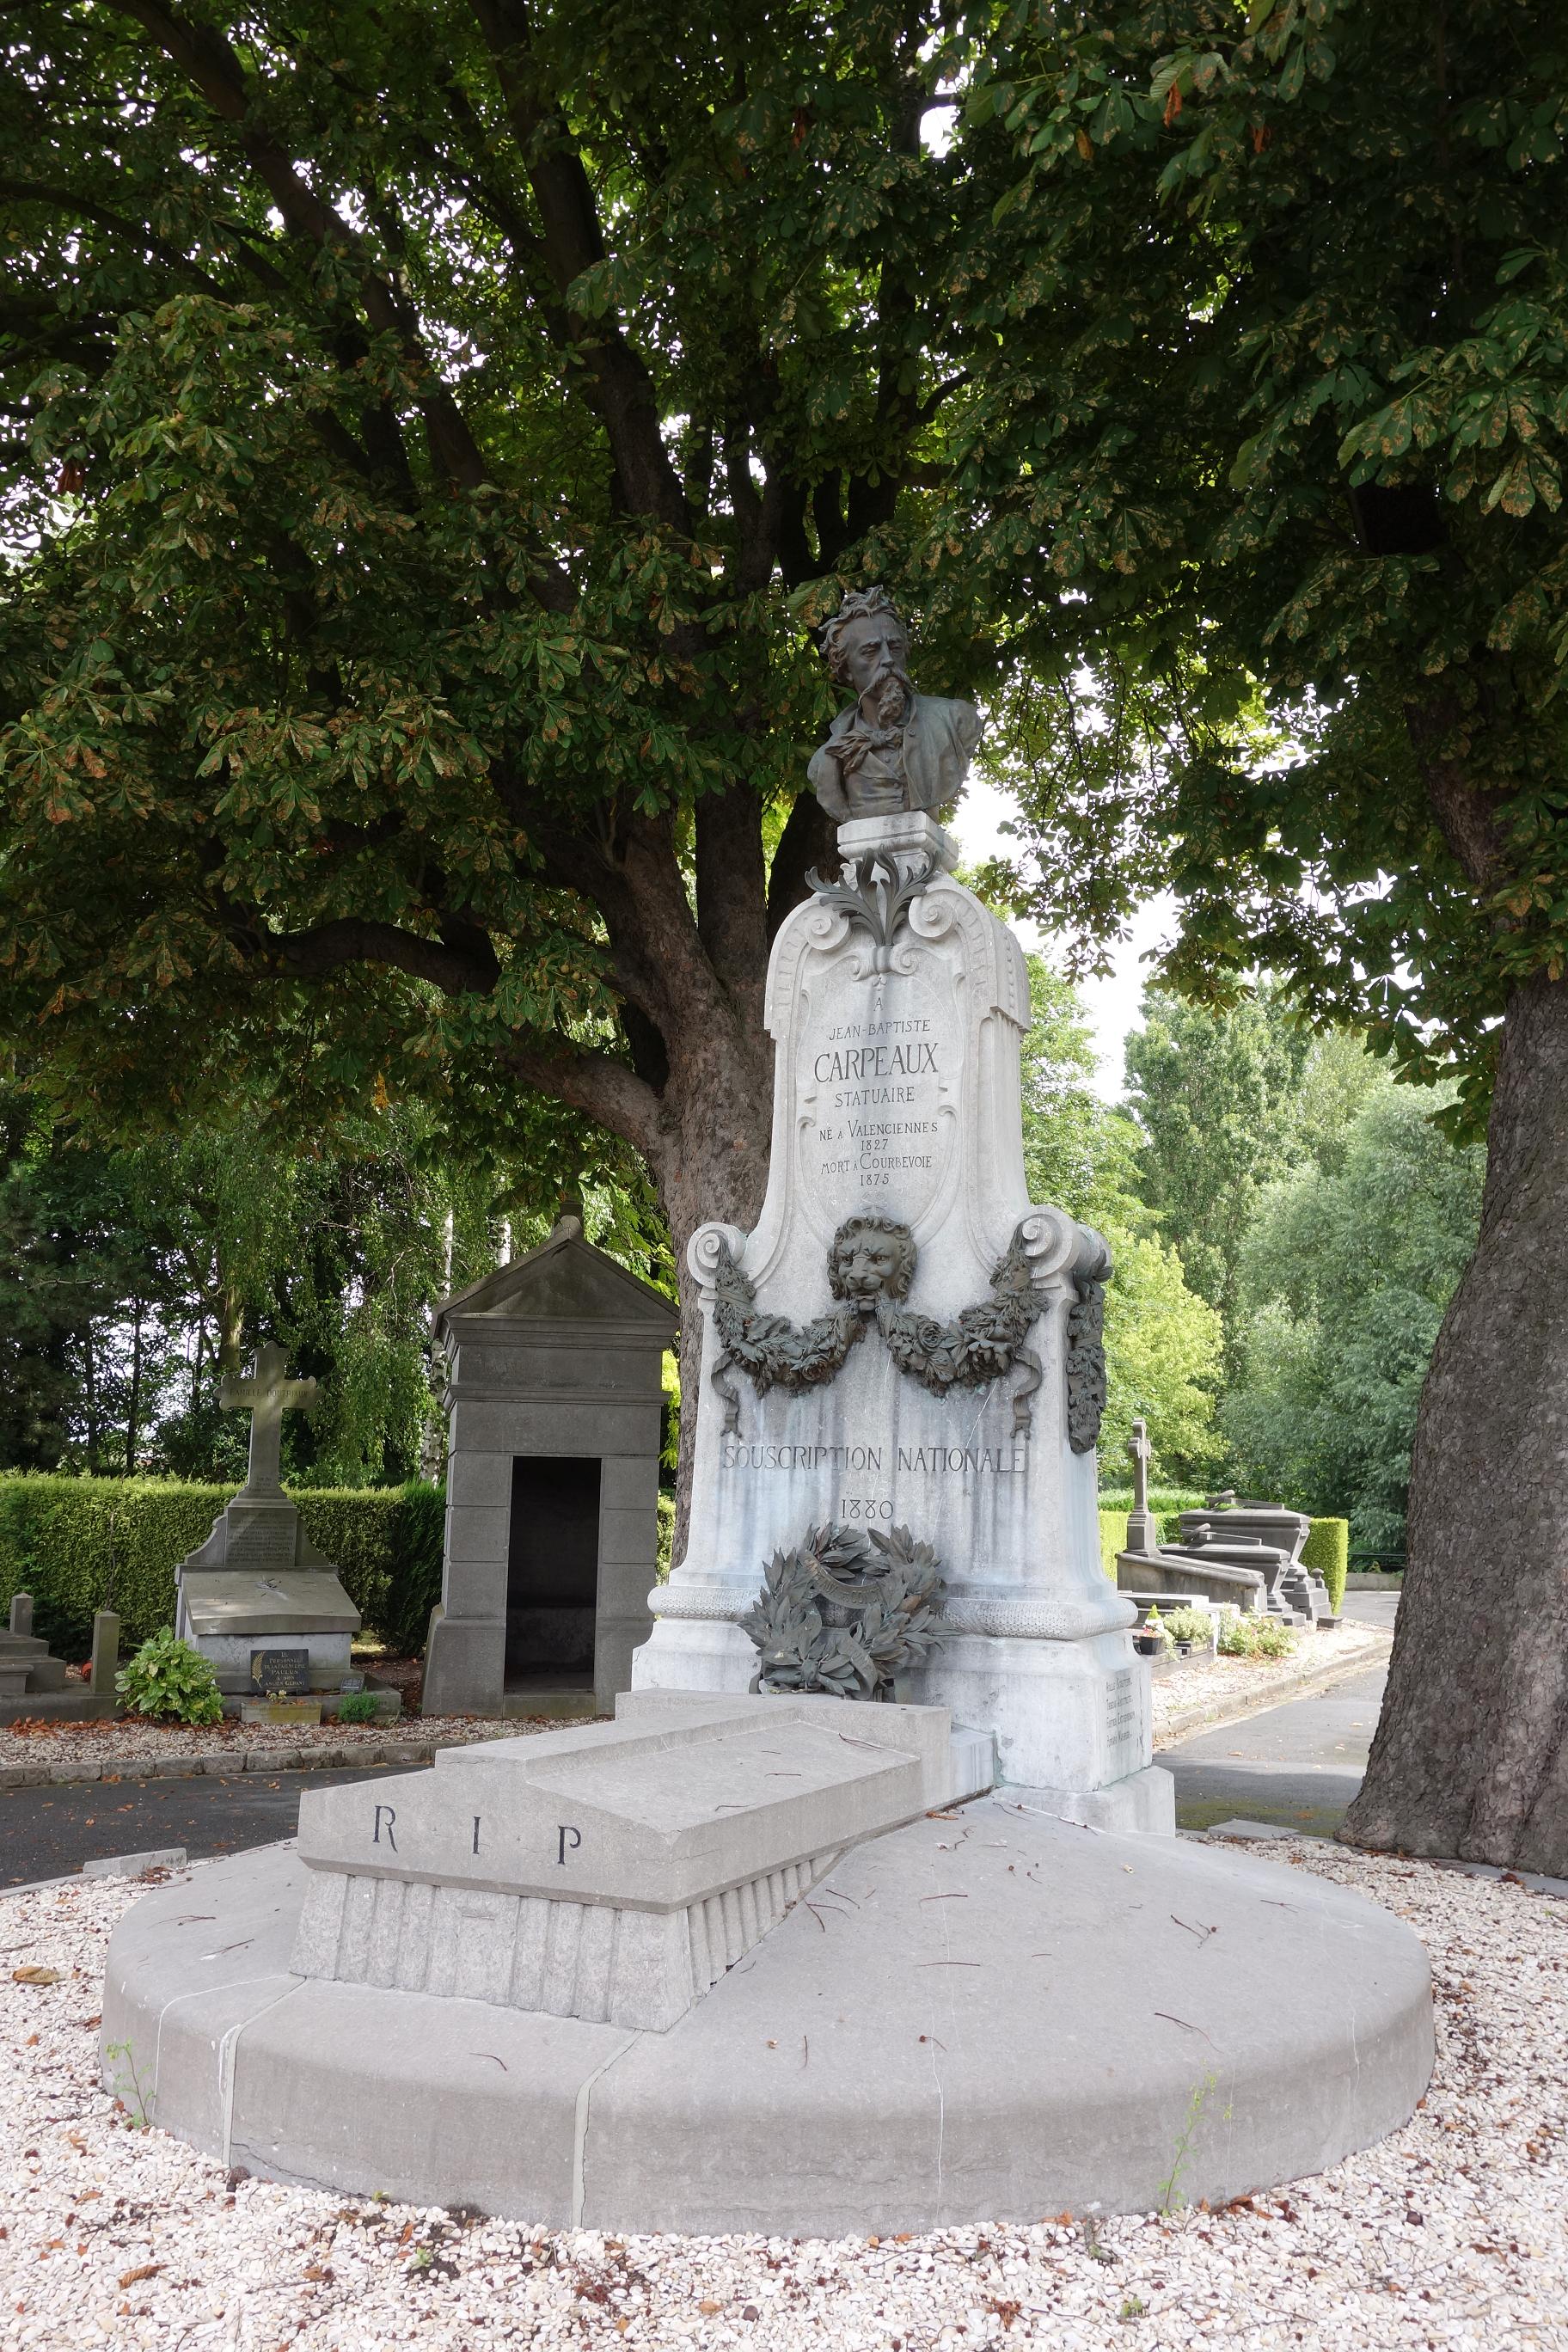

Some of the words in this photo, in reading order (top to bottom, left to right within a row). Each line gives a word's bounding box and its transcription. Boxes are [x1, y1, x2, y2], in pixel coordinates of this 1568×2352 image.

[873, 997, 884, 1011] A
[829, 1020, 930, 1041] JEAN-BAPTISTE
[814, 1043, 939, 1082] CARPEAUX
[835, 1087, 915, 1107] STATUAIRE
[819, 1127, 833, 1141] NÉ
[848, 1119, 938, 1137] VALENCIENNES
[861, 1139, 889, 1151] 1827
[821, 1161, 850, 1175] MORT
[860, 1152, 932, 1170] COURBEVOIE
[860, 1173, 890, 1186] 1875
[722, 1445, 882, 1472] SOUSCRIPTION
[897, 1447, 1026, 1473] NATIONALE
[842, 1499, 894, 1520] 1880
